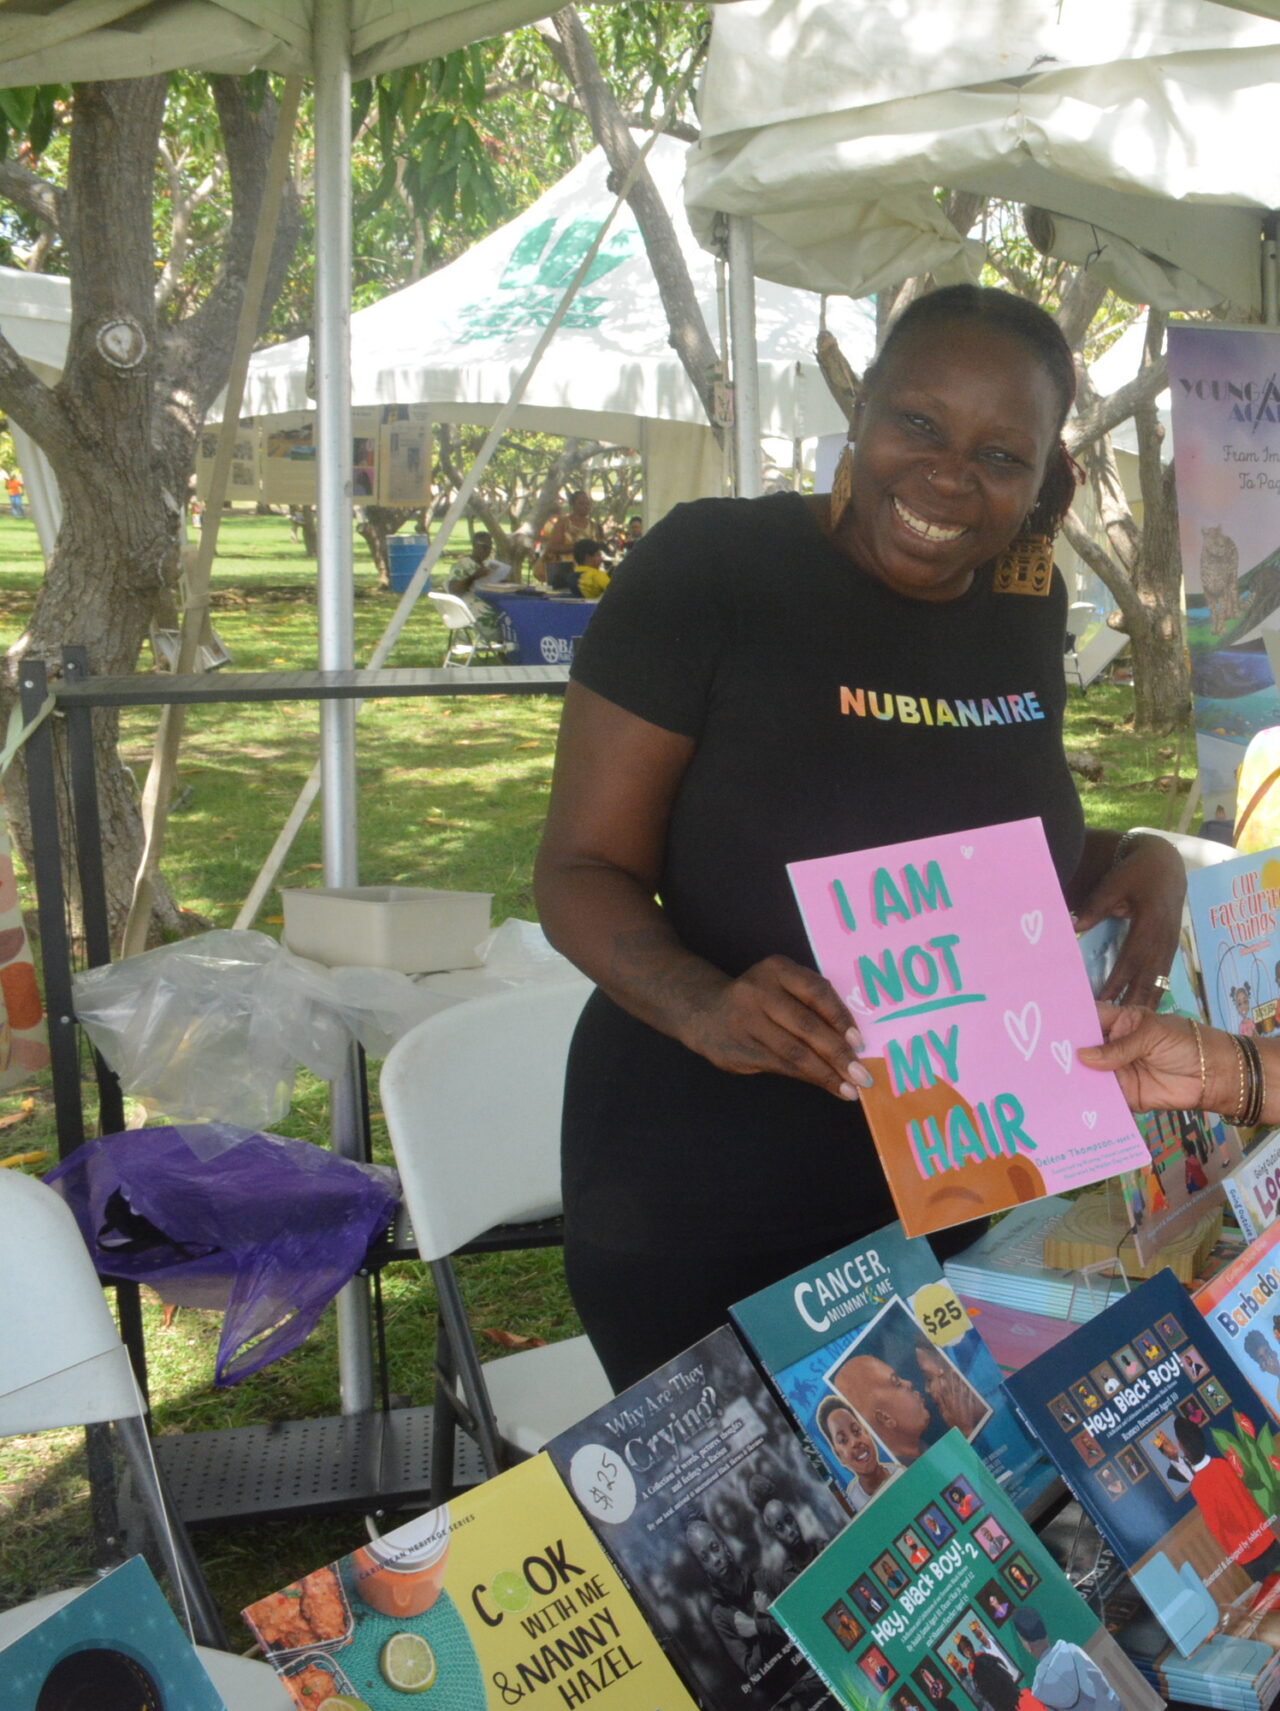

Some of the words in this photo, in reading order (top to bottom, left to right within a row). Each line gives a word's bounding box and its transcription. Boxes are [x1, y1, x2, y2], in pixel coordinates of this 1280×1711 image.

[1180, 379, 1259, 401] YOUNG
[1223, 445, 1259, 462] From
[1239, 473, 1255, 490] To
[839, 685, 1045, 728] NUBIANAIRE
[829, 878, 855, 932] I
[870, 860, 953, 927] AM
[855, 933, 963, 1009] NOT
[883, 1024, 960, 1098] MY
[906, 1092, 1037, 1180] HAIR
[794, 1249, 891, 1333] CANCER,
[827, 1293, 868, 1324] MUMMY
[876, 1278, 894, 1294] ME
[922, 1300, 962, 1336] $25
[605, 1408, 646, 1438] Why
[646, 1387, 673, 1415] Are
[668, 1364, 705, 1394] They
[624, 1386, 718, 1473] Crying?
[1083, 1406, 1120, 1438] Hey,
[1113, 1374, 1151, 1410] Black
[358, 1551, 406, 1580] CARIBBEAN
[408, 1529, 447, 1554] HERITAGE
[449, 1513, 476, 1531] SERIES
[966, 1544, 979, 1561] 2
[520, 1595, 579, 1639] WITH
[576, 1574, 611, 1607] ME
[871, 1616, 905, 1647] Hey,
[900, 1574, 934, 1615] Black
[492, 1671, 522, 1705] &
[515, 1607, 621, 1685] NANNY
[557, 1644, 642, 1711] HAZEL
